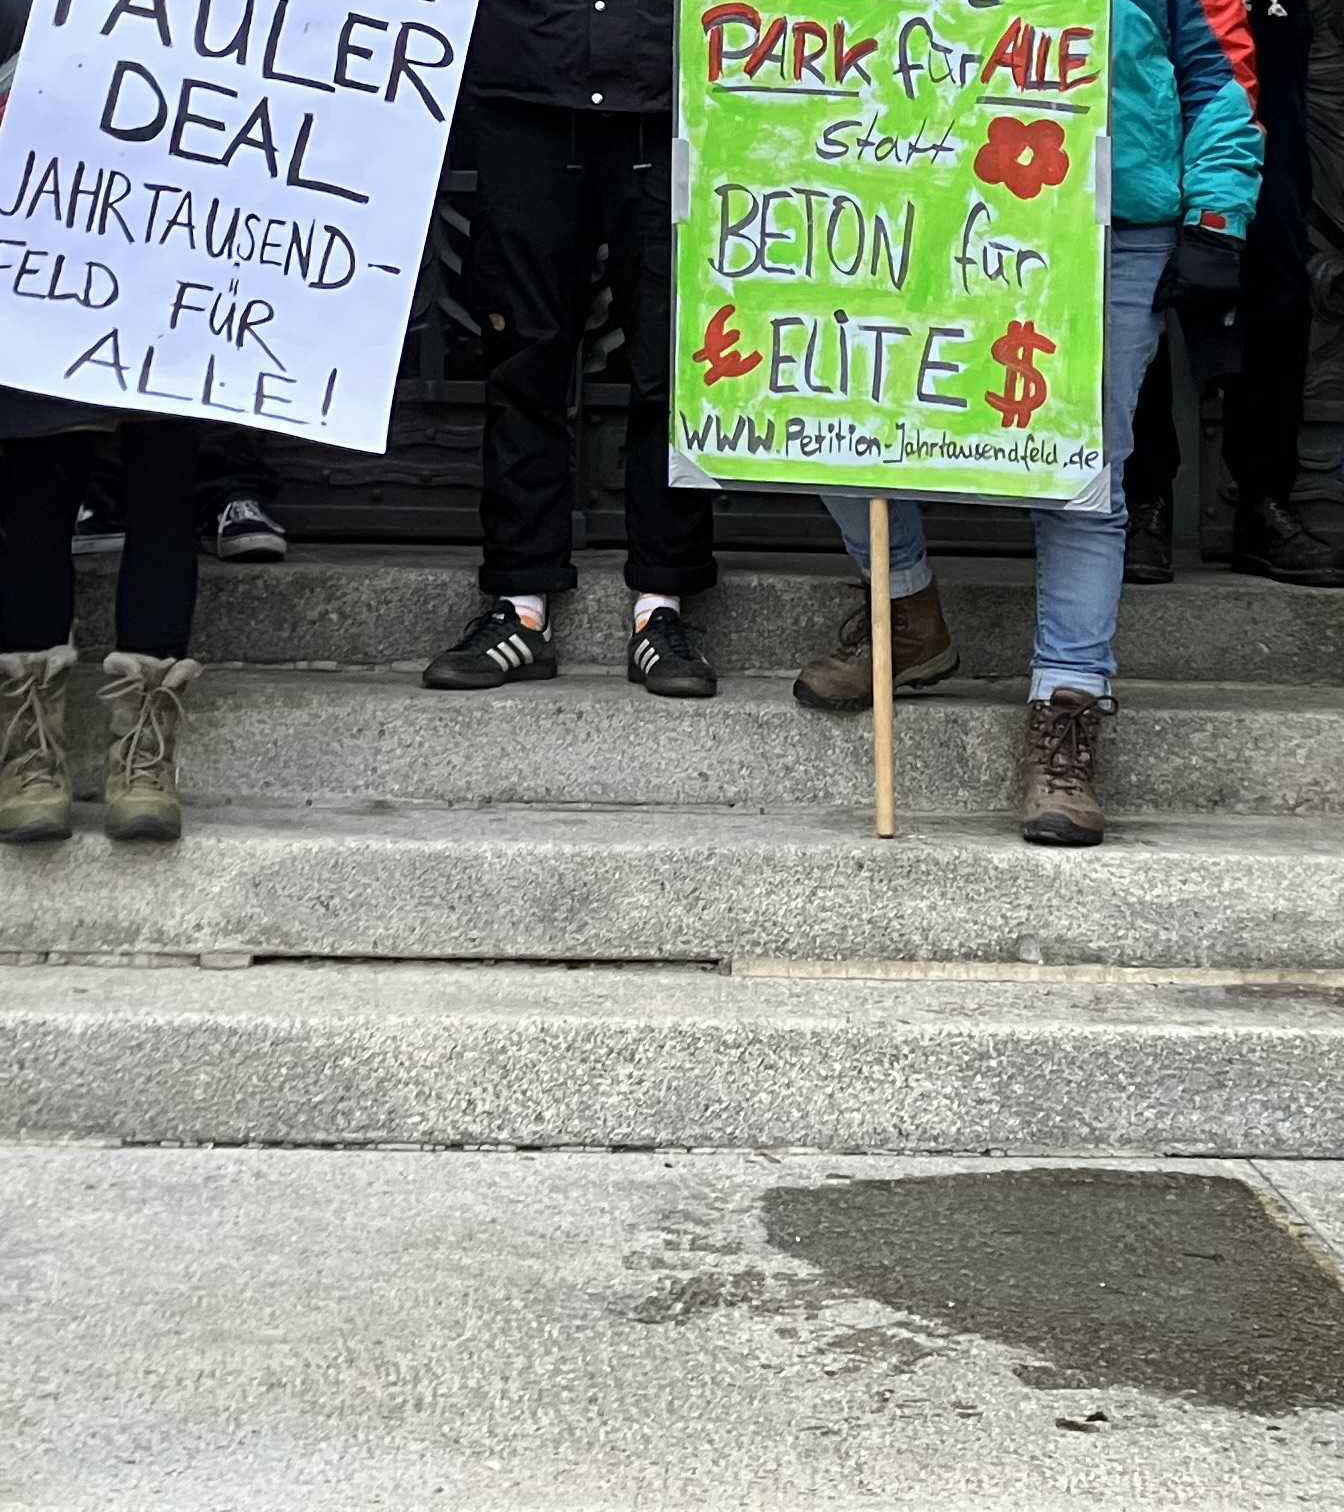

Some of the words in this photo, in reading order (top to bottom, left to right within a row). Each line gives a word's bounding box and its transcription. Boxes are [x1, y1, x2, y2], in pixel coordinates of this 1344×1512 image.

[701, 2, 878, 86] PARK
[980, 16, 1101, 93] ALLE
[99, 60, 370, 205] DEAL
[709, 184, 915, 291] BETON
[169, 277, 288, 373] FÜR
[64, 326, 338, 427] ALLE!
